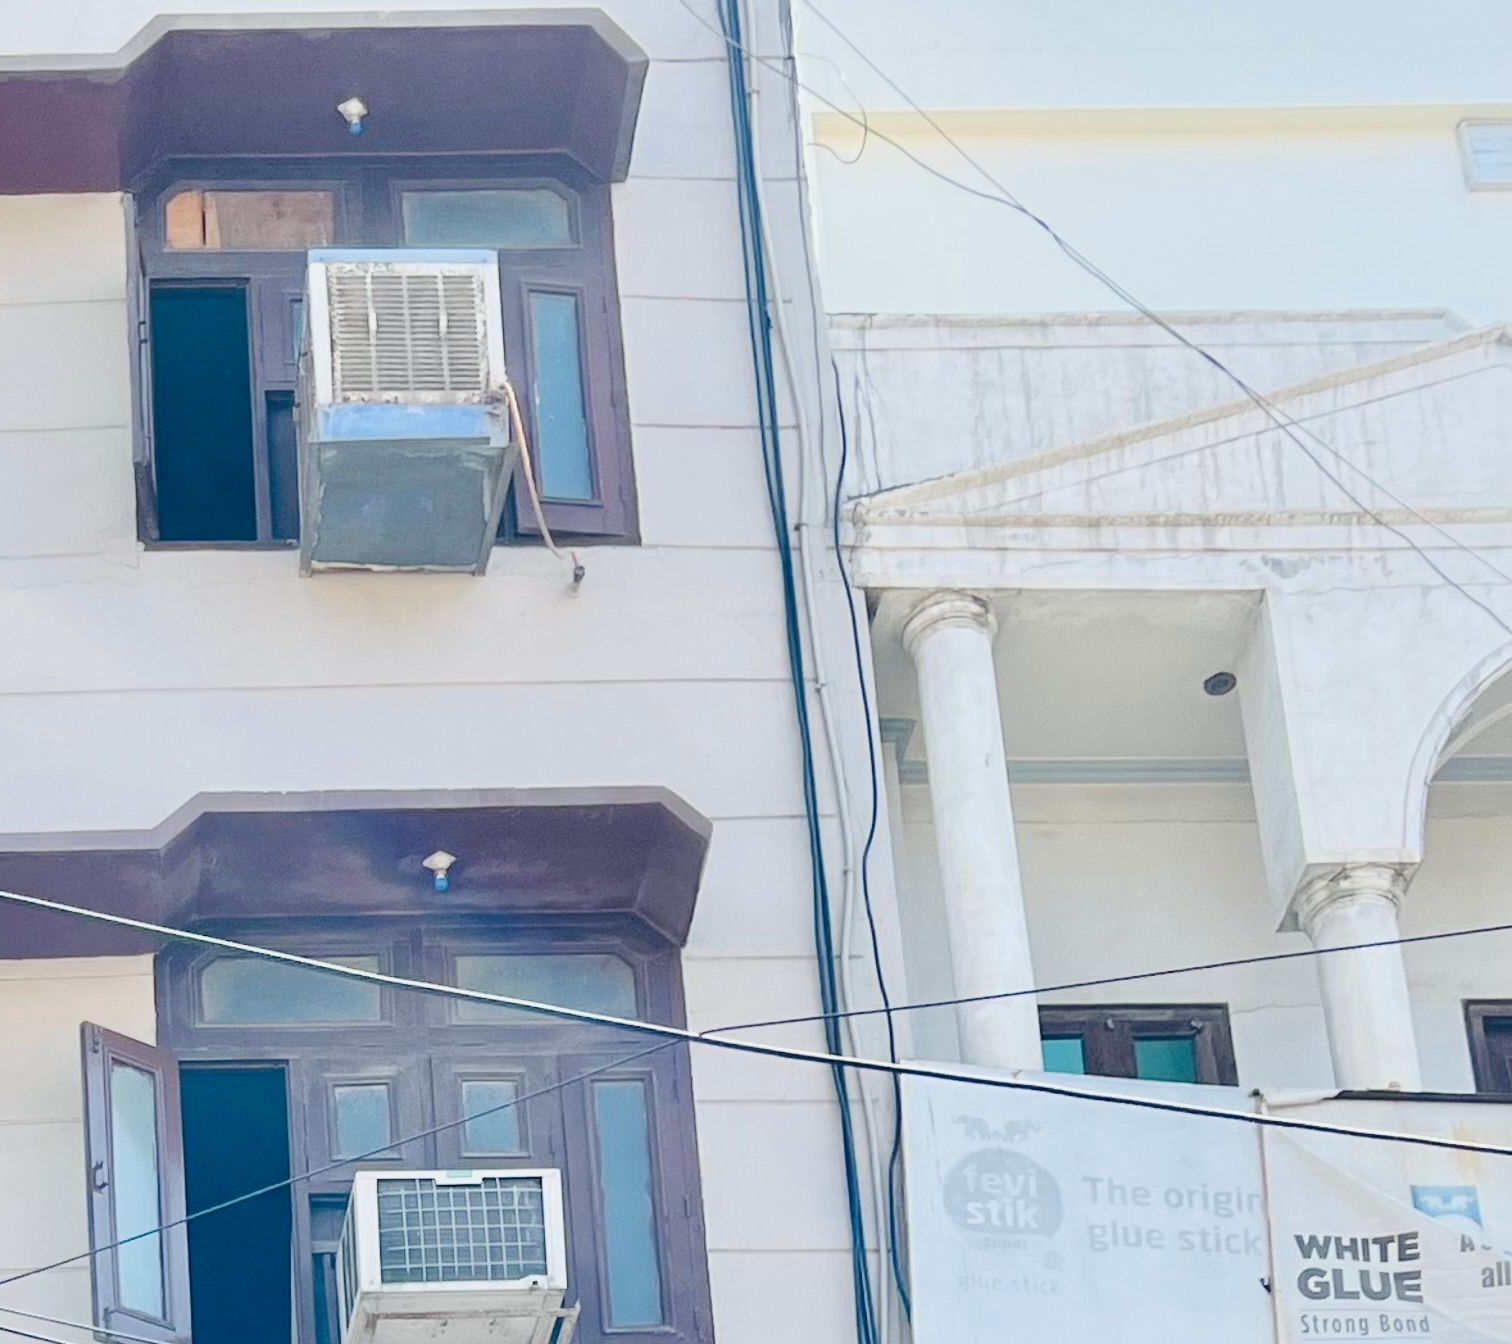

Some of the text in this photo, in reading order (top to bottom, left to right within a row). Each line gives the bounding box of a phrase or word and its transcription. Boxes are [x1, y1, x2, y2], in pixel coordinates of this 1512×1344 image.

[963, 1163, 1037, 1197] fevi
[1082, 1176, 1151, 1207] The
[966, 1197, 1039, 1229] stik
[1088, 1220, 1262, 1257] glue stick
[1293, 1231, 1420, 1262] WHITE
[958, 1272, 1060, 1295] glue stick
[1297, 1269, 1424, 1303] GLUE
[1300, 1313, 1430, 1336] Strong Bond
